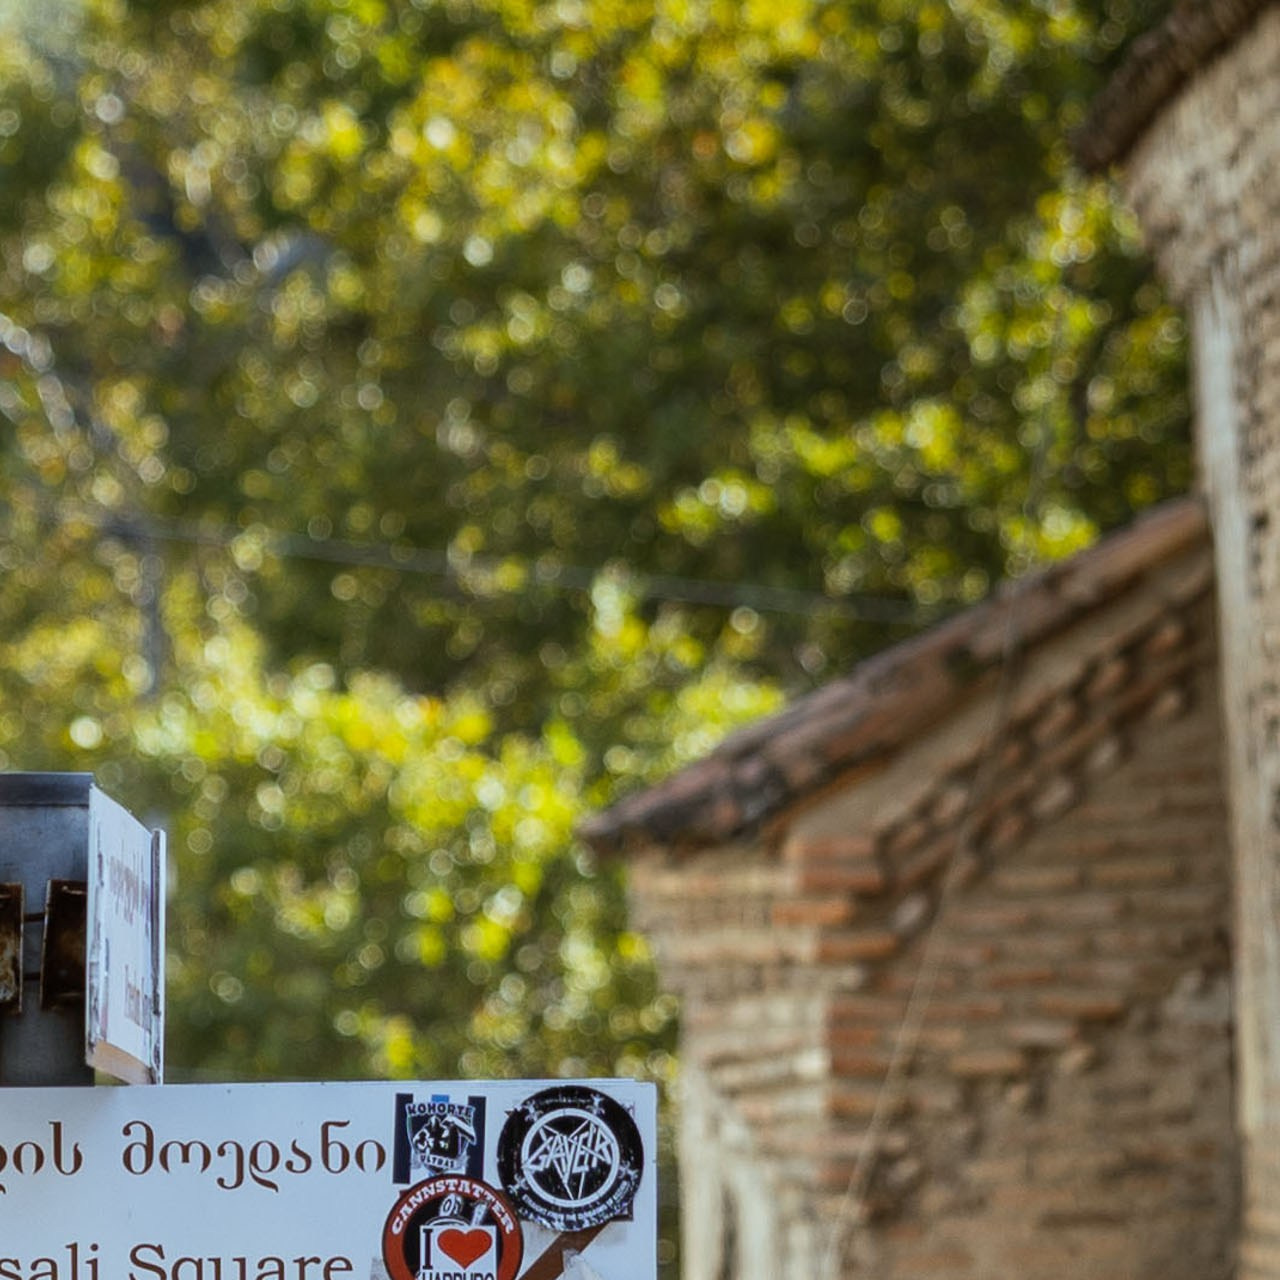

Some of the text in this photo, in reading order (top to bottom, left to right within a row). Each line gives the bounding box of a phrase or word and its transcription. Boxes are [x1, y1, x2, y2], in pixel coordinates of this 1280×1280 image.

[407, 1103, 474, 1118] KOHORTE
[122, 1120, 387, 1192] მოედანი
[392, 1178, 515, 1236] CANNSTATTER
[422, 1228, 434, 1270] I
